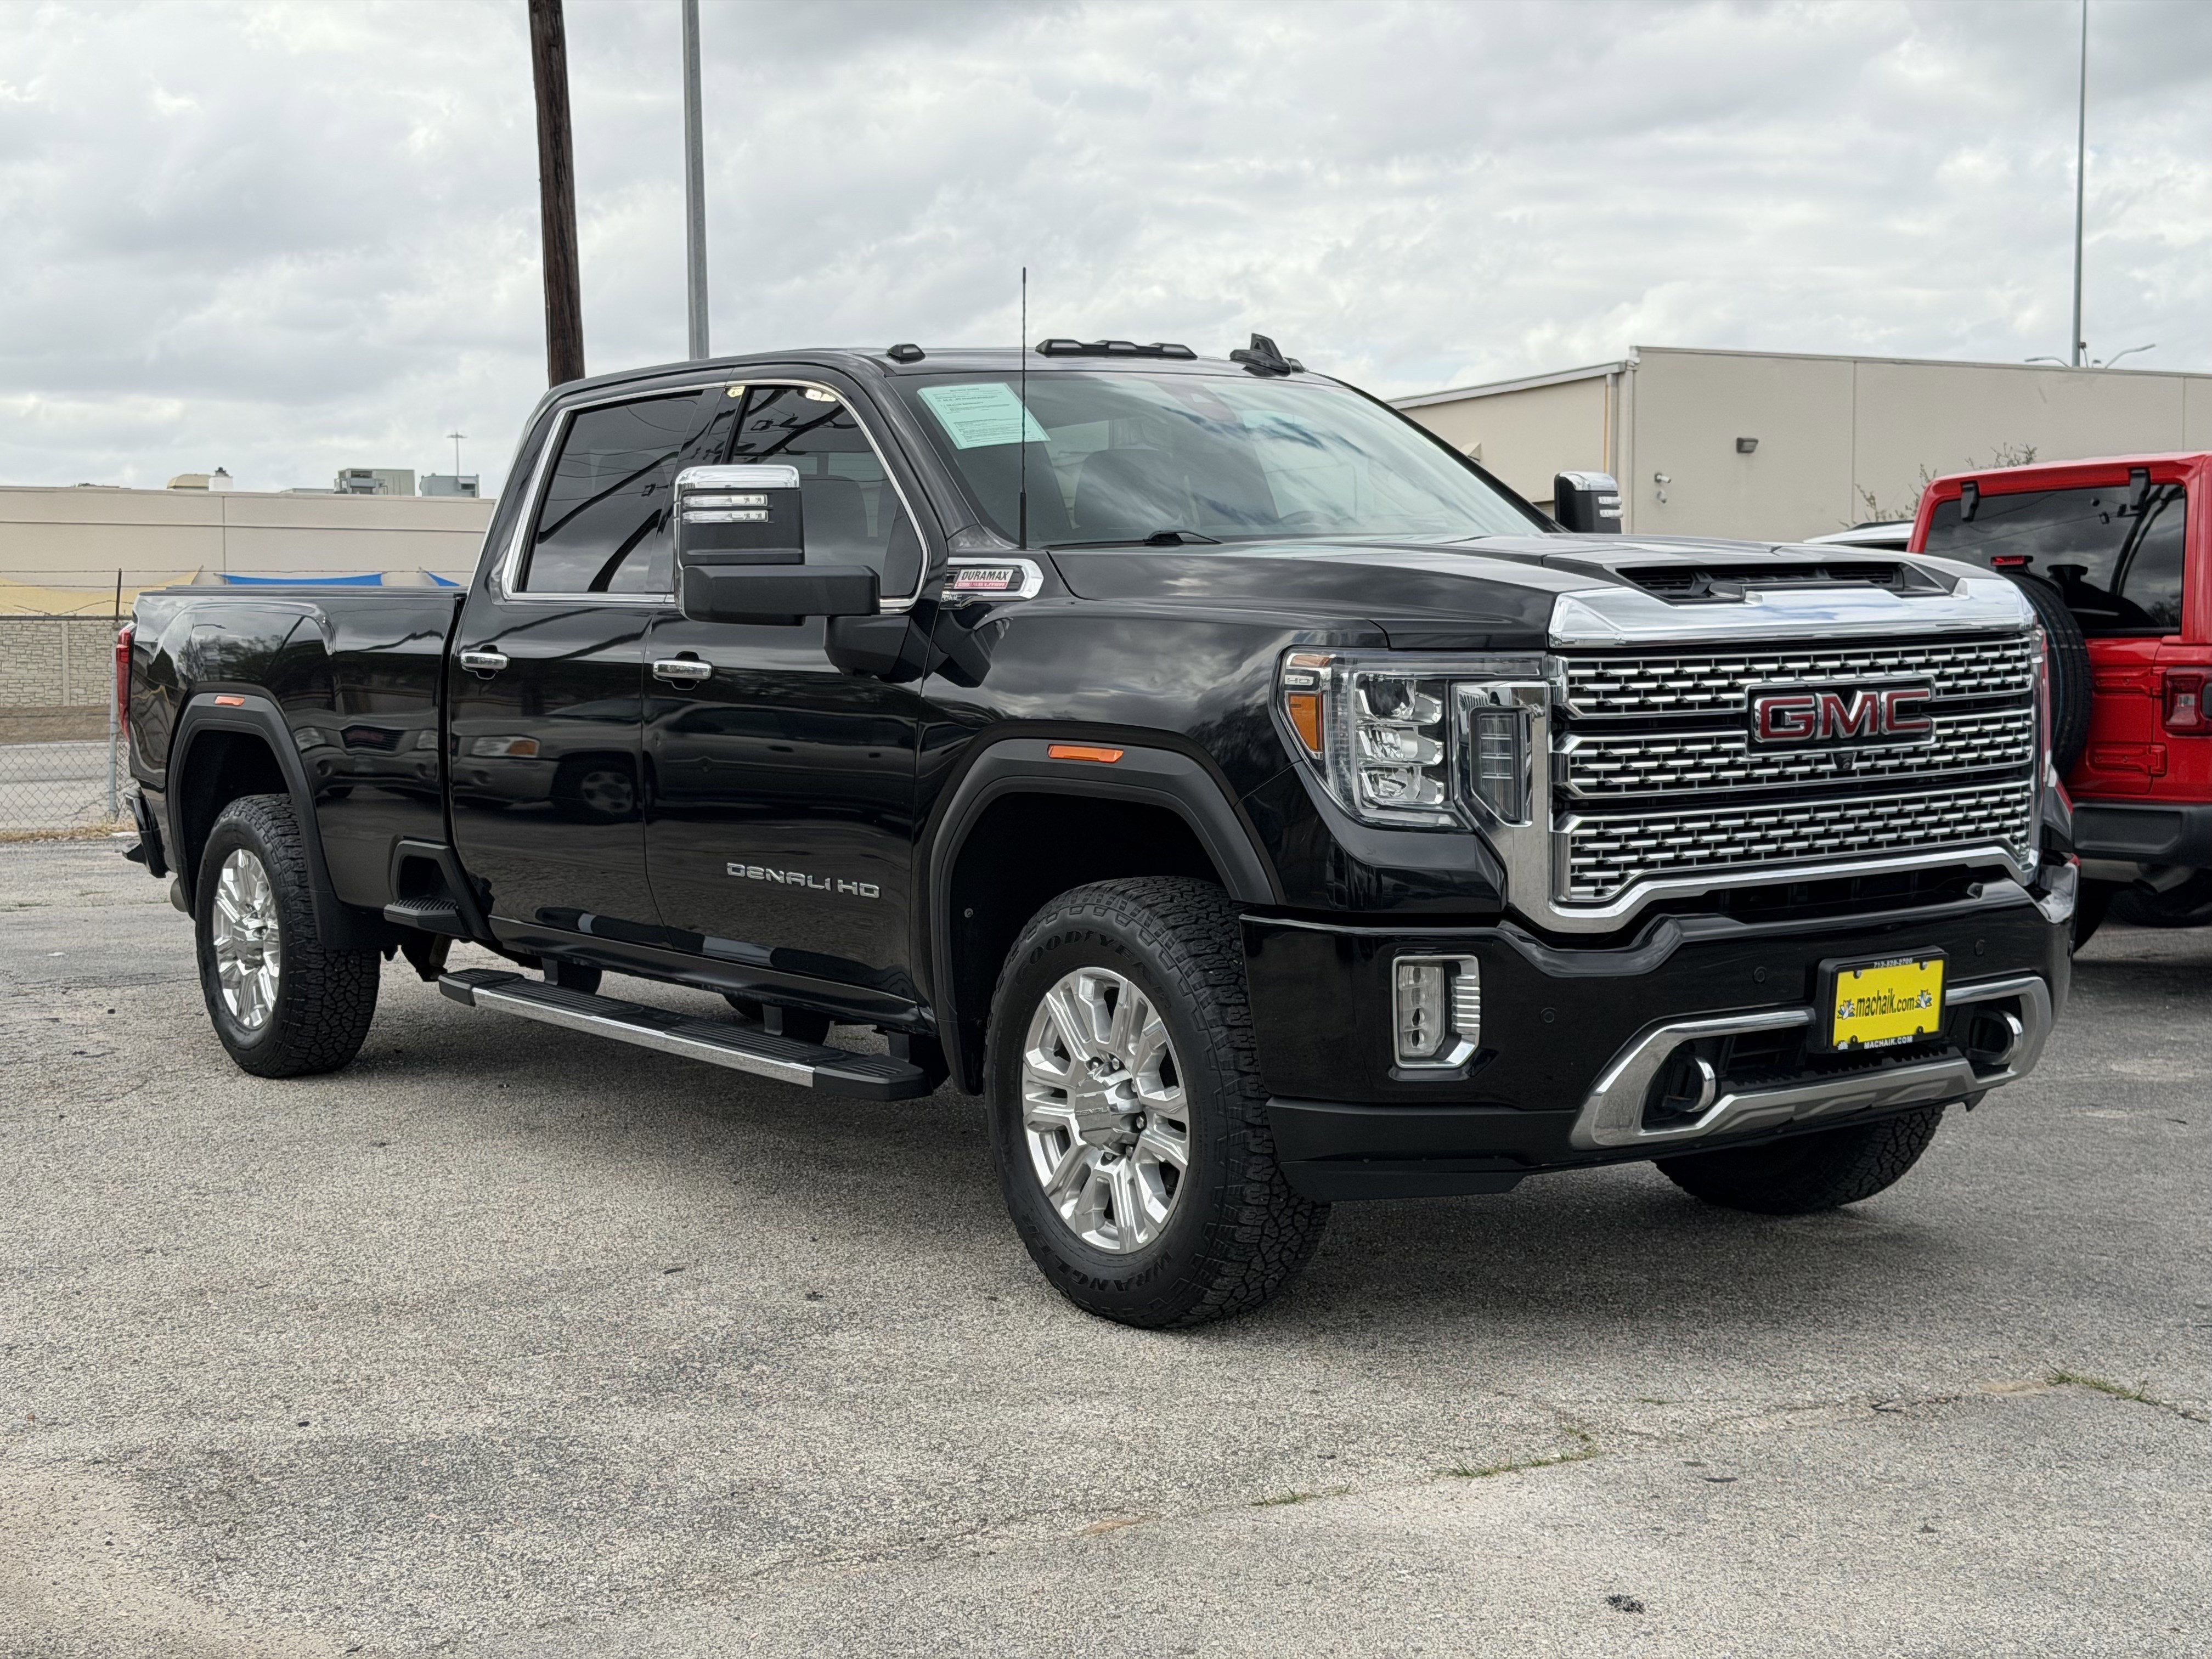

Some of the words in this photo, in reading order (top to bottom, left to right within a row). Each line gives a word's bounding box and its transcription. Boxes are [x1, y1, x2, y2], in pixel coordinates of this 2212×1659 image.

[961, 571, 1009, 580] DURAMAX
[1754, 688, 1931, 743] GMC
[727, 862, 831, 891] DENALI
[838, 879, 879, 899] HD
[1856, 988, 1915, 1018] machaik.com
[1864, 1035, 1913, 1049] MACHAIK.COM
